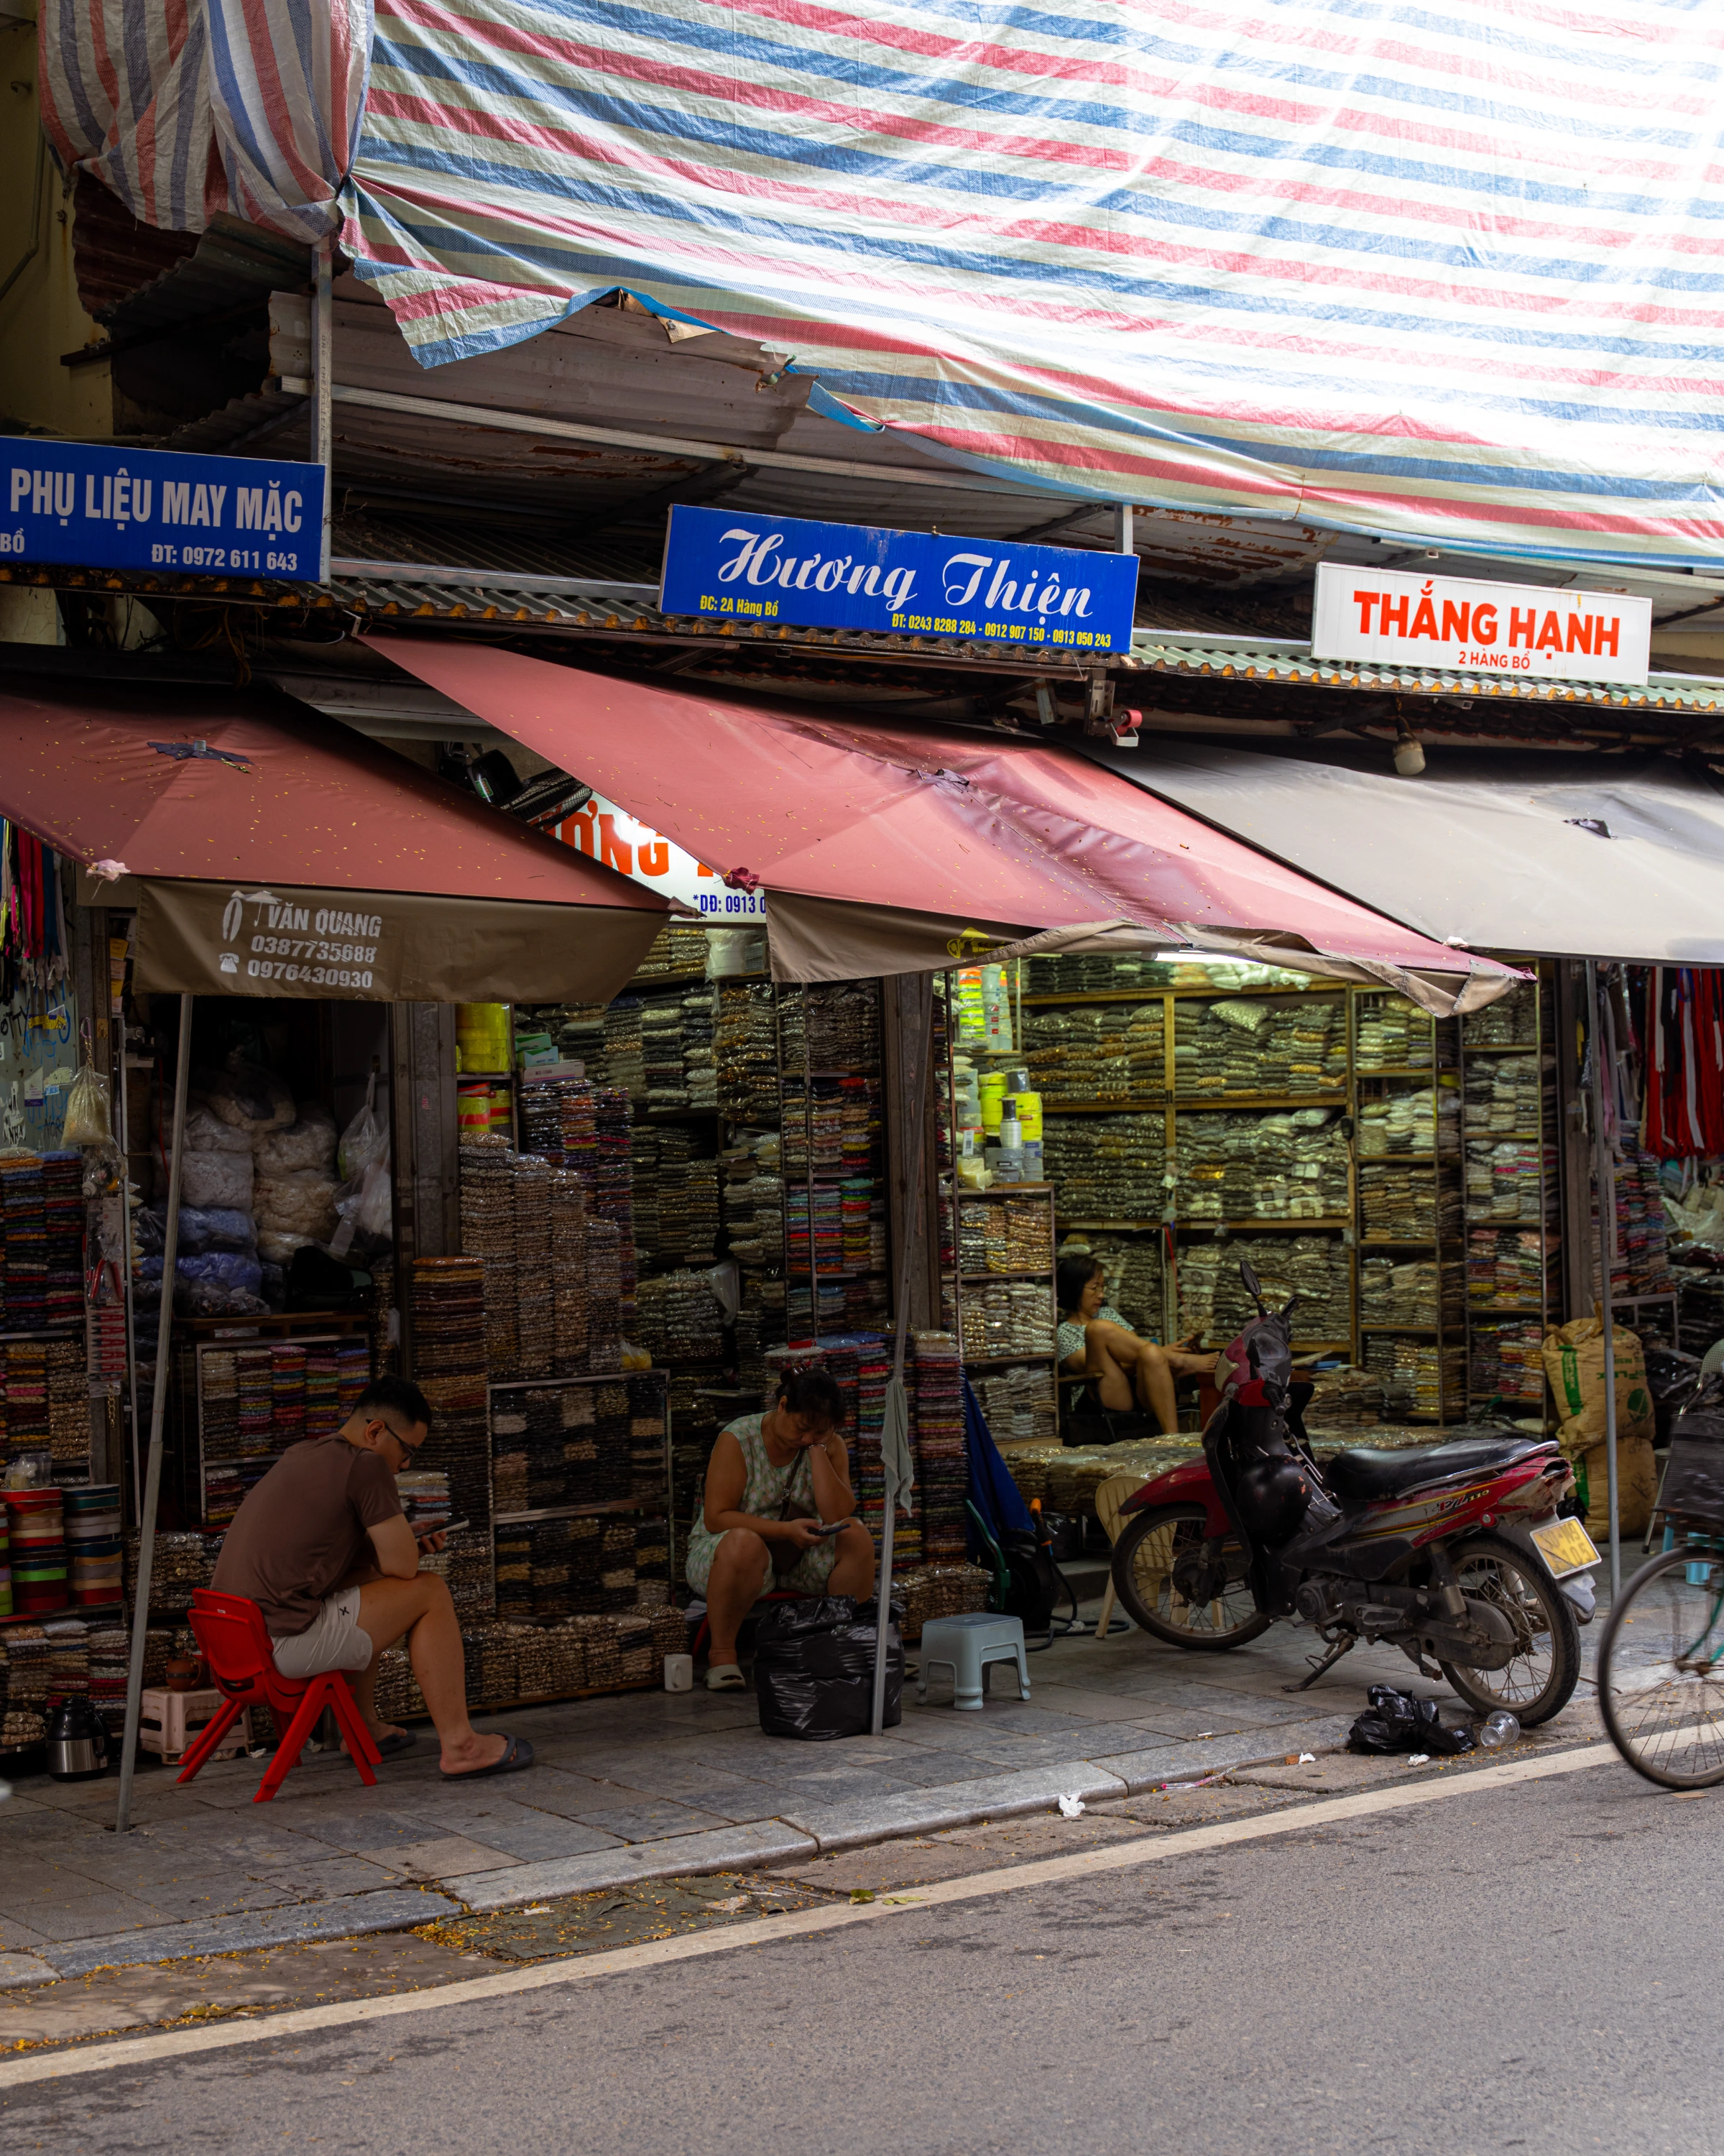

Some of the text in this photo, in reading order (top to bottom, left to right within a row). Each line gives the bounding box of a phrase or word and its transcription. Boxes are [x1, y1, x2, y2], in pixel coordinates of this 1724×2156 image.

[11, 468, 303, 540] PHỤ LIỆU MAY MẶC
[152, 544, 298, 571] ĐT: 0972 611 643
[719, 528, 1093, 625] Hương Thiện
[700, 596, 779, 617] ĐC: 2A Hàng Bồ
[1353, 580, 1620, 660] THẮNG HẠNH
[892, 613, 907, 627] ĐT:
[908, 615, 933, 631] 0243
[934, 617, 957, 633] 8288
[959, 620, 976, 635] 284
[985, 622, 1008, 637] 0912
[1010, 625, 1026, 639] 907
[1028, 627, 1044, 641] 150
[1054, 630, 1076, 644] 0913
[1077, 632, 1093, 645] 050
[1095, 633, 1112, 648] 243
[1459, 649, 1531, 670] 2 HÀNG BỒ
[725, 895, 756, 913] 0913
[268, 902, 382, 937] VĂN QUANG
[252, 935, 377, 963] 0387735688
[248, 959, 373, 988] 0976430930
